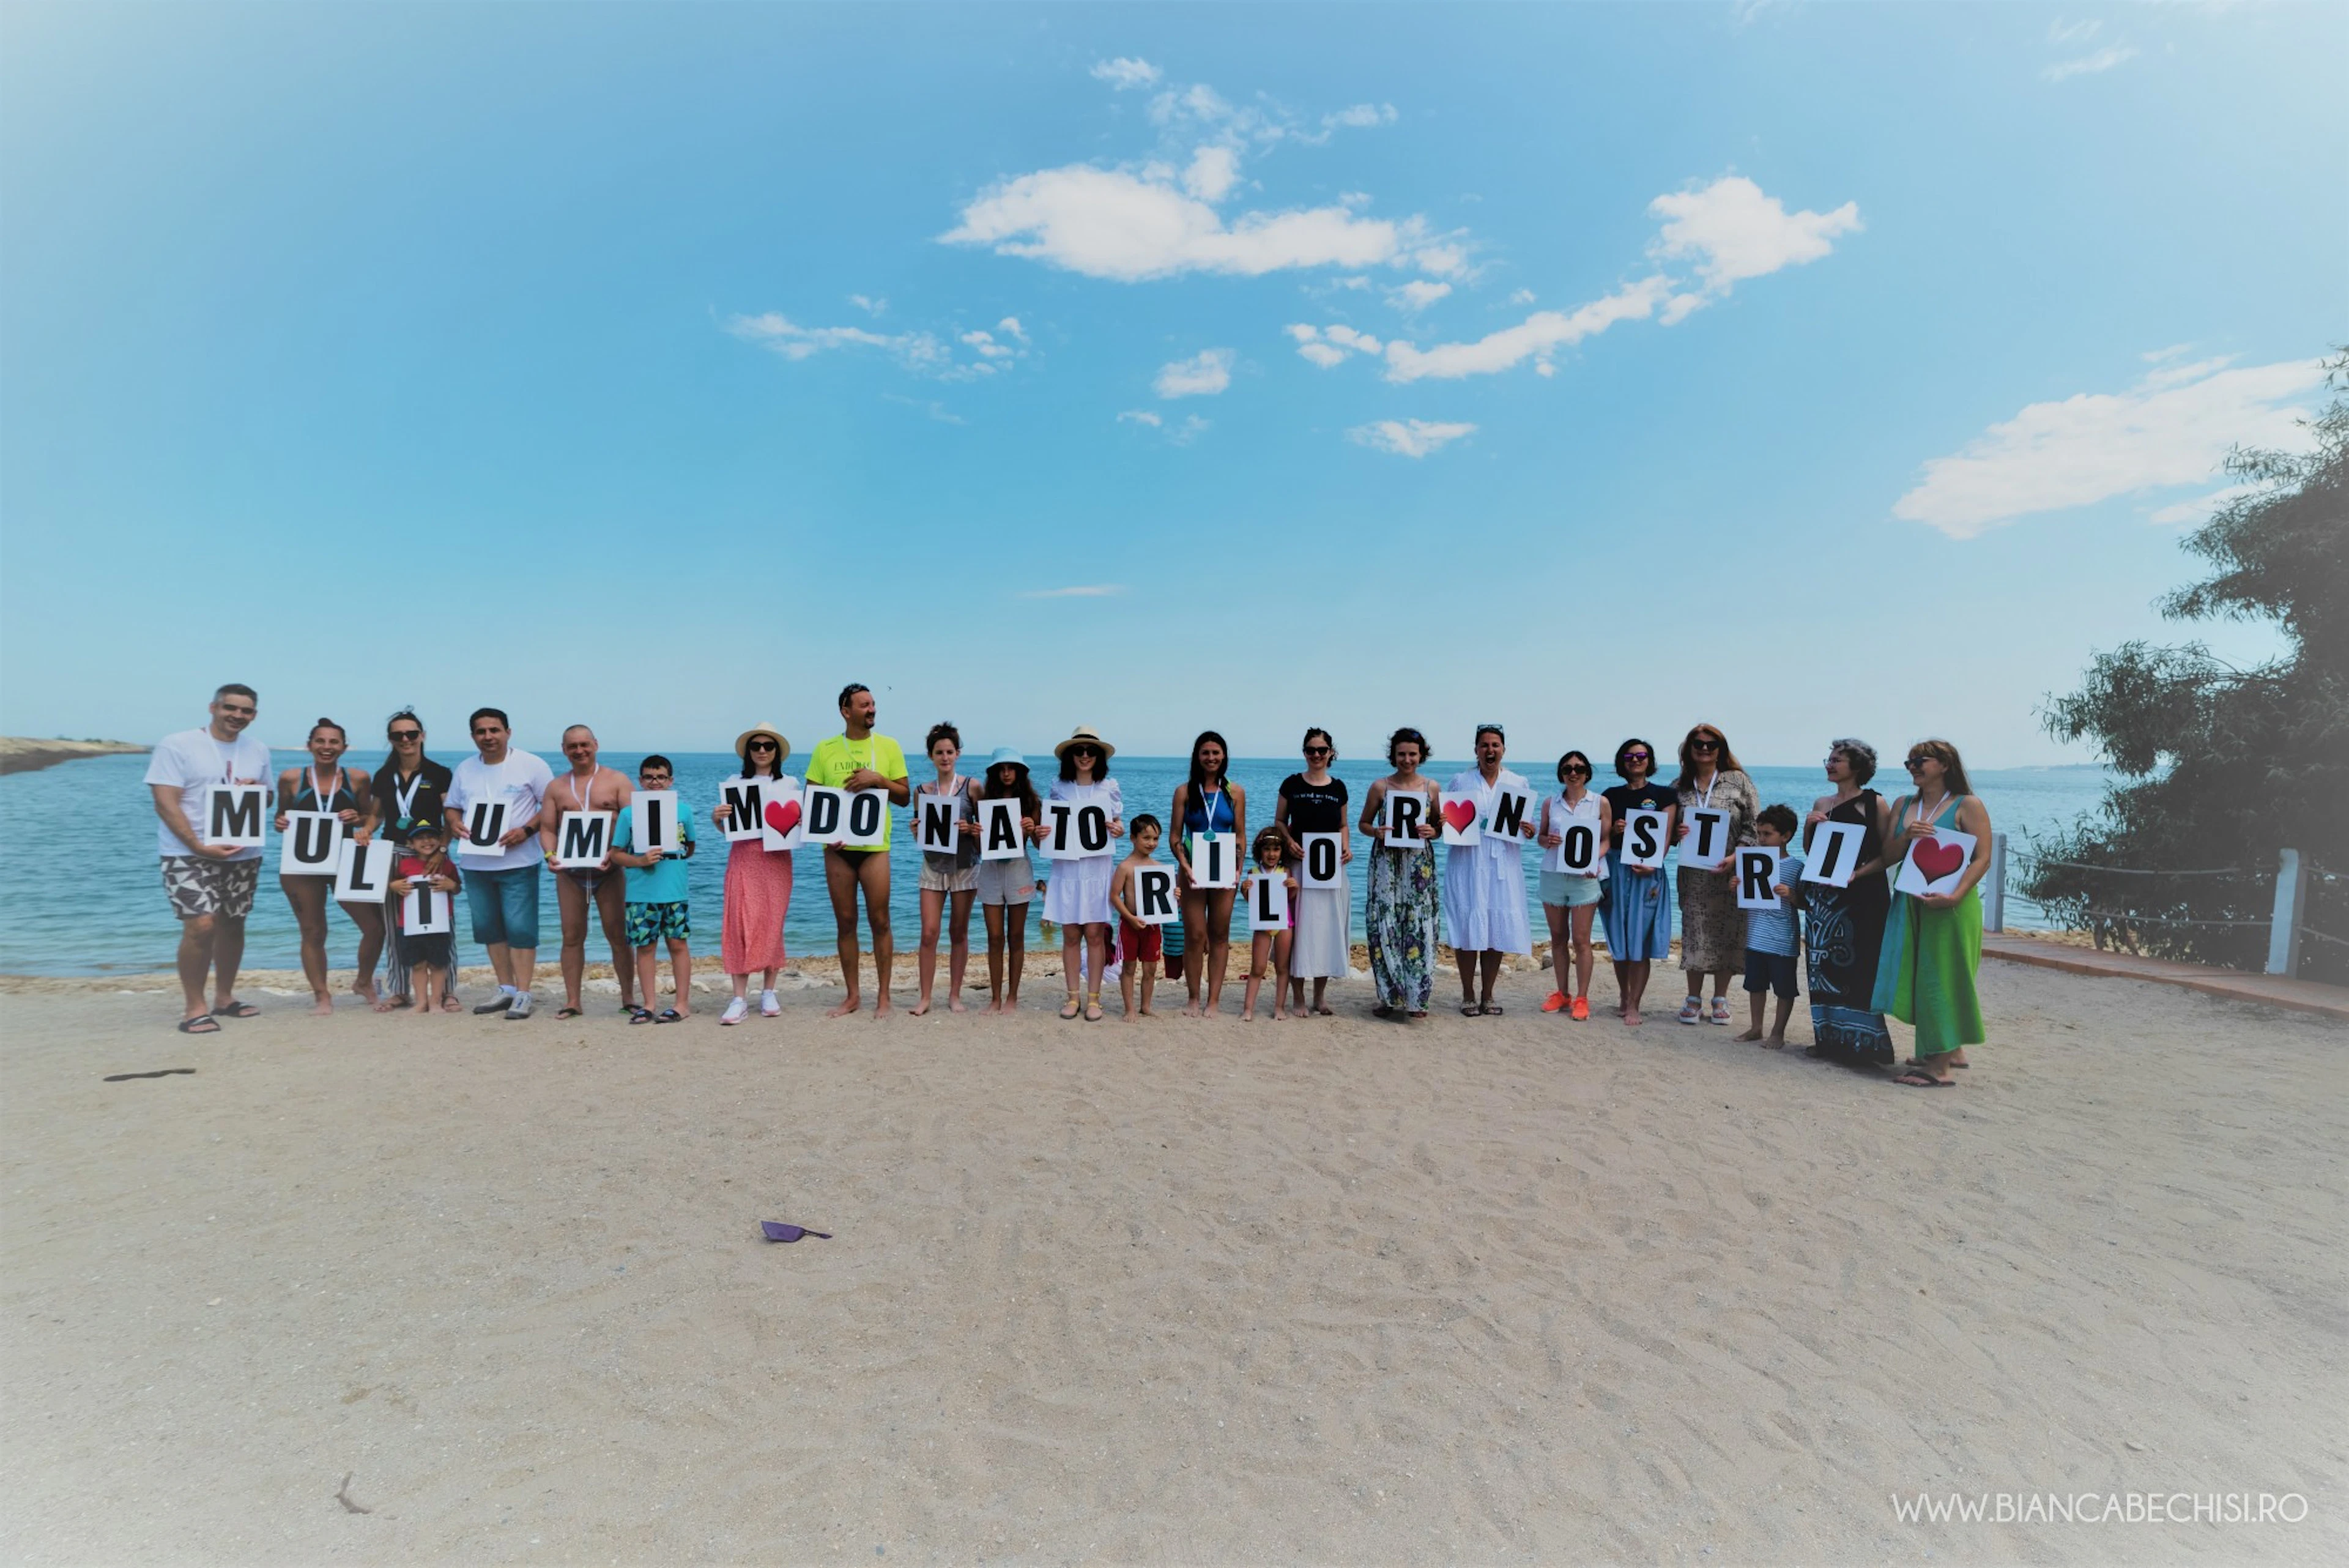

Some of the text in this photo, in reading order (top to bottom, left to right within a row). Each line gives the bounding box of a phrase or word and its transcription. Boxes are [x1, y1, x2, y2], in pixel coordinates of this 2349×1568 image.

[212, 791, 259, 836] M
[470, 803, 505, 847] U
[648, 800, 661, 846] I
[725, 785, 762, 832] M
[809, 791, 840, 834] D
[850, 793, 880, 836] O
[925, 803, 952, 847] N
[988, 804, 1017, 851] A
[1050, 806, 1071, 850] T
[1078, 805, 1108, 851] O
[1392, 796, 1421, 839] R
[1493, 792, 1527, 838] N
[295, 817, 332, 863] U
[563, 817, 604, 858] M
[1564, 825, 1593, 869] O
[1694, 812, 1721, 856] T
[1819, 831, 1844, 878] I
[350, 845, 374, 890] L
[1209, 841, 1220, 881] I
[1308, 838, 1336, 882] O
[1742, 852, 1774, 901] R
[1141, 871, 1172, 916] R
[1258, 879, 1280, 921] L
